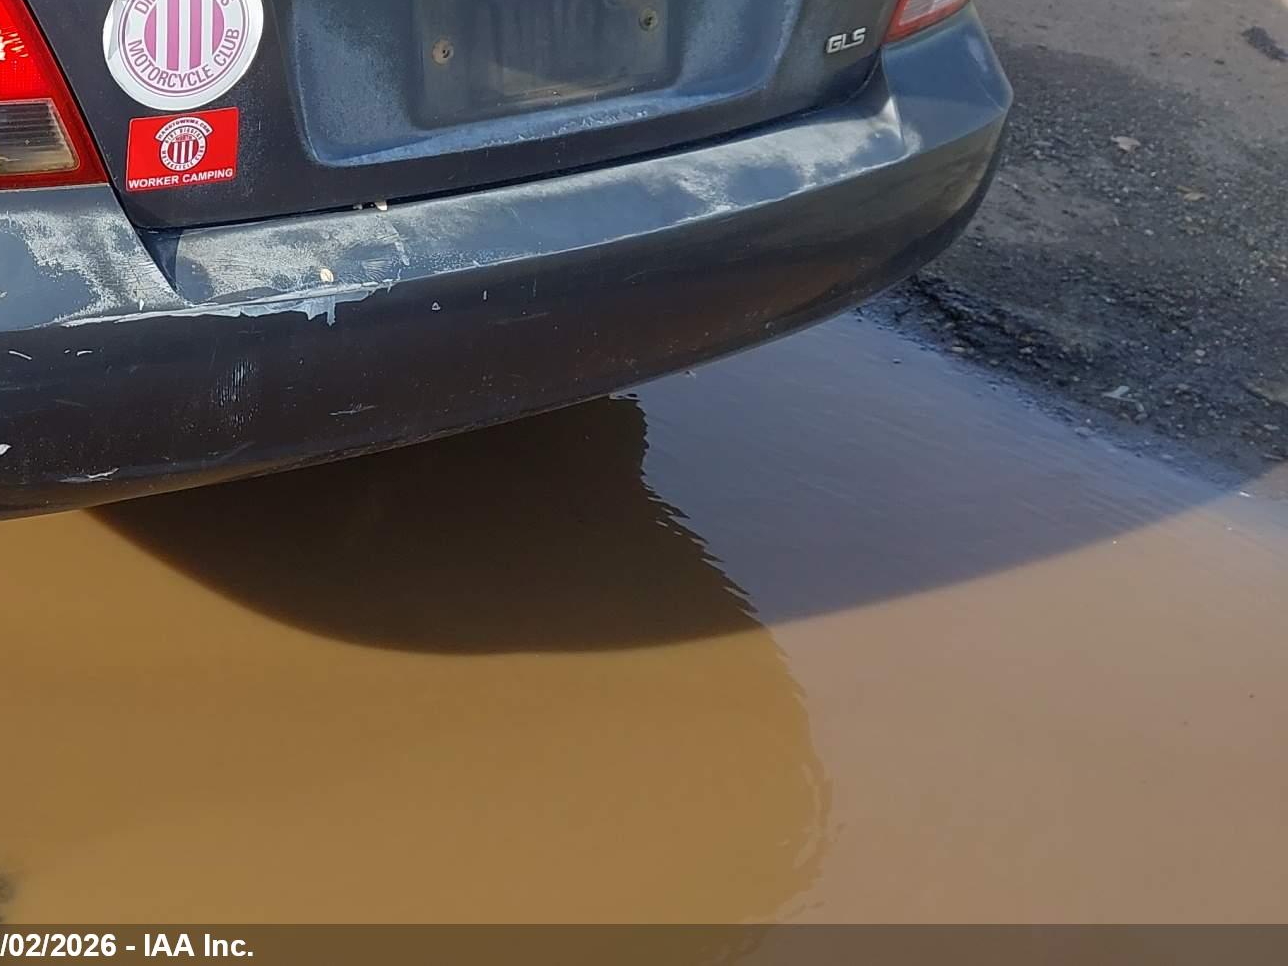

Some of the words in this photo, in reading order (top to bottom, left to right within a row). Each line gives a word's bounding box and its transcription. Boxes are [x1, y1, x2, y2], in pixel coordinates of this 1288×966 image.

[826, 27, 867, 54] GLS
[128, 39, 214, 88] MOTORCYCLE
[213, 28, 240, 67] CLUB
[128, 175, 179, 189] WORKER
[182, 168, 233, 183] CAMPING
